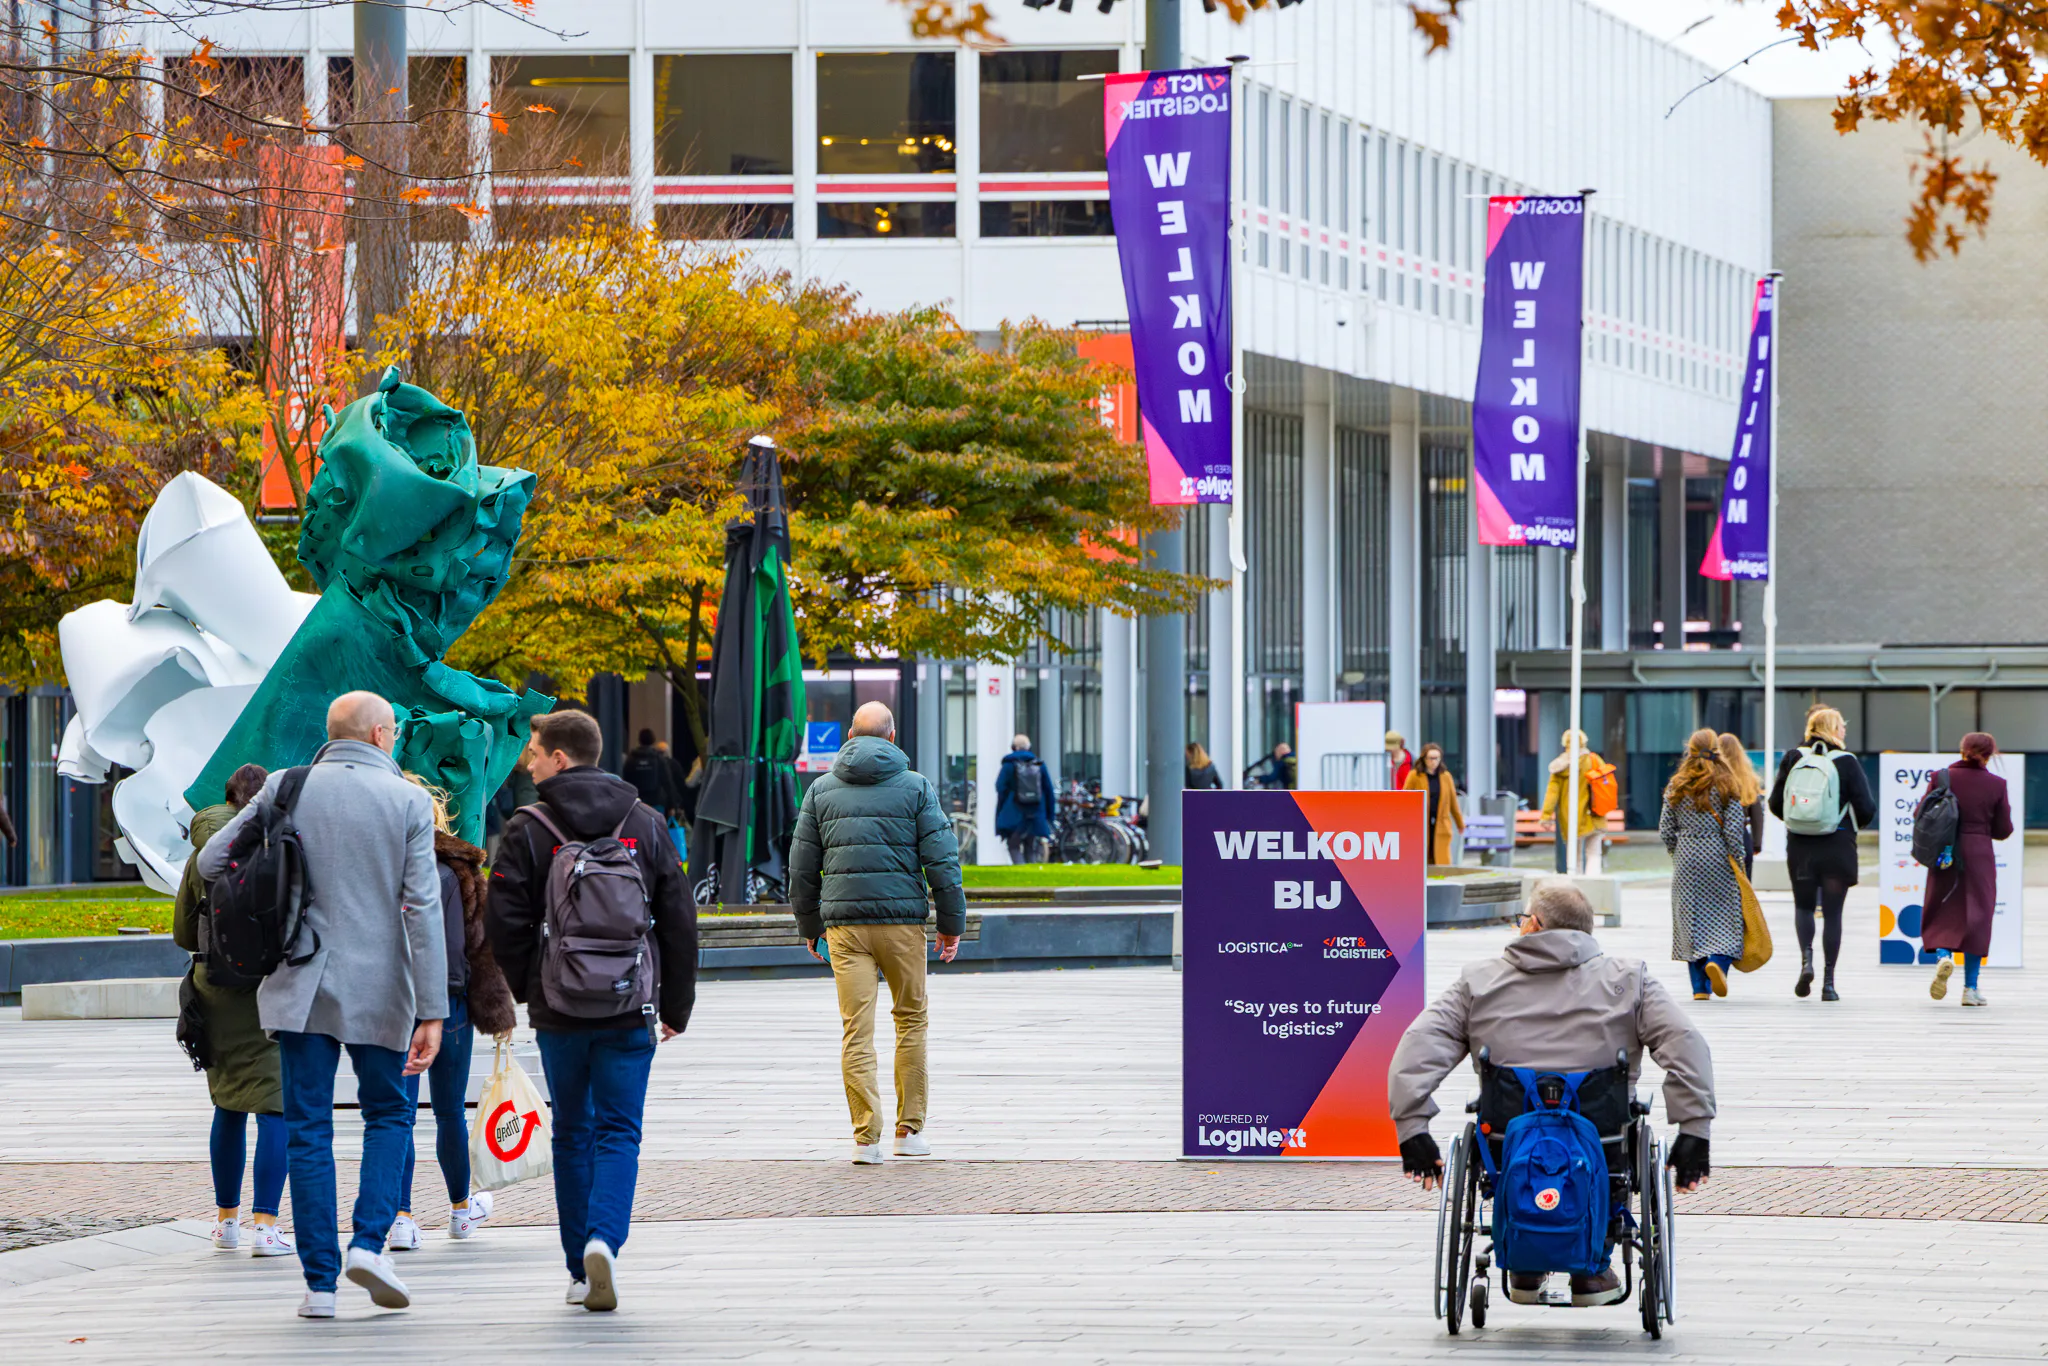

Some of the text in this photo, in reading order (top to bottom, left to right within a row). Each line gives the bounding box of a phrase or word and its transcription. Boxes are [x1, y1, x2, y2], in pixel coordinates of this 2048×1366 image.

[1213, 831, 1400, 860] WELKOM
[1274, 880, 1342, 910] BIJ
[1218, 941, 1288, 953] LOGISTICA
[1224, 1000, 1382, 1017] “Say yes to future
[1262, 1020, 1343, 1040] logistics”
[1198, 1114, 1269, 1124] POWERED BY
[1198, 1126, 1307, 1153] LogiNext
